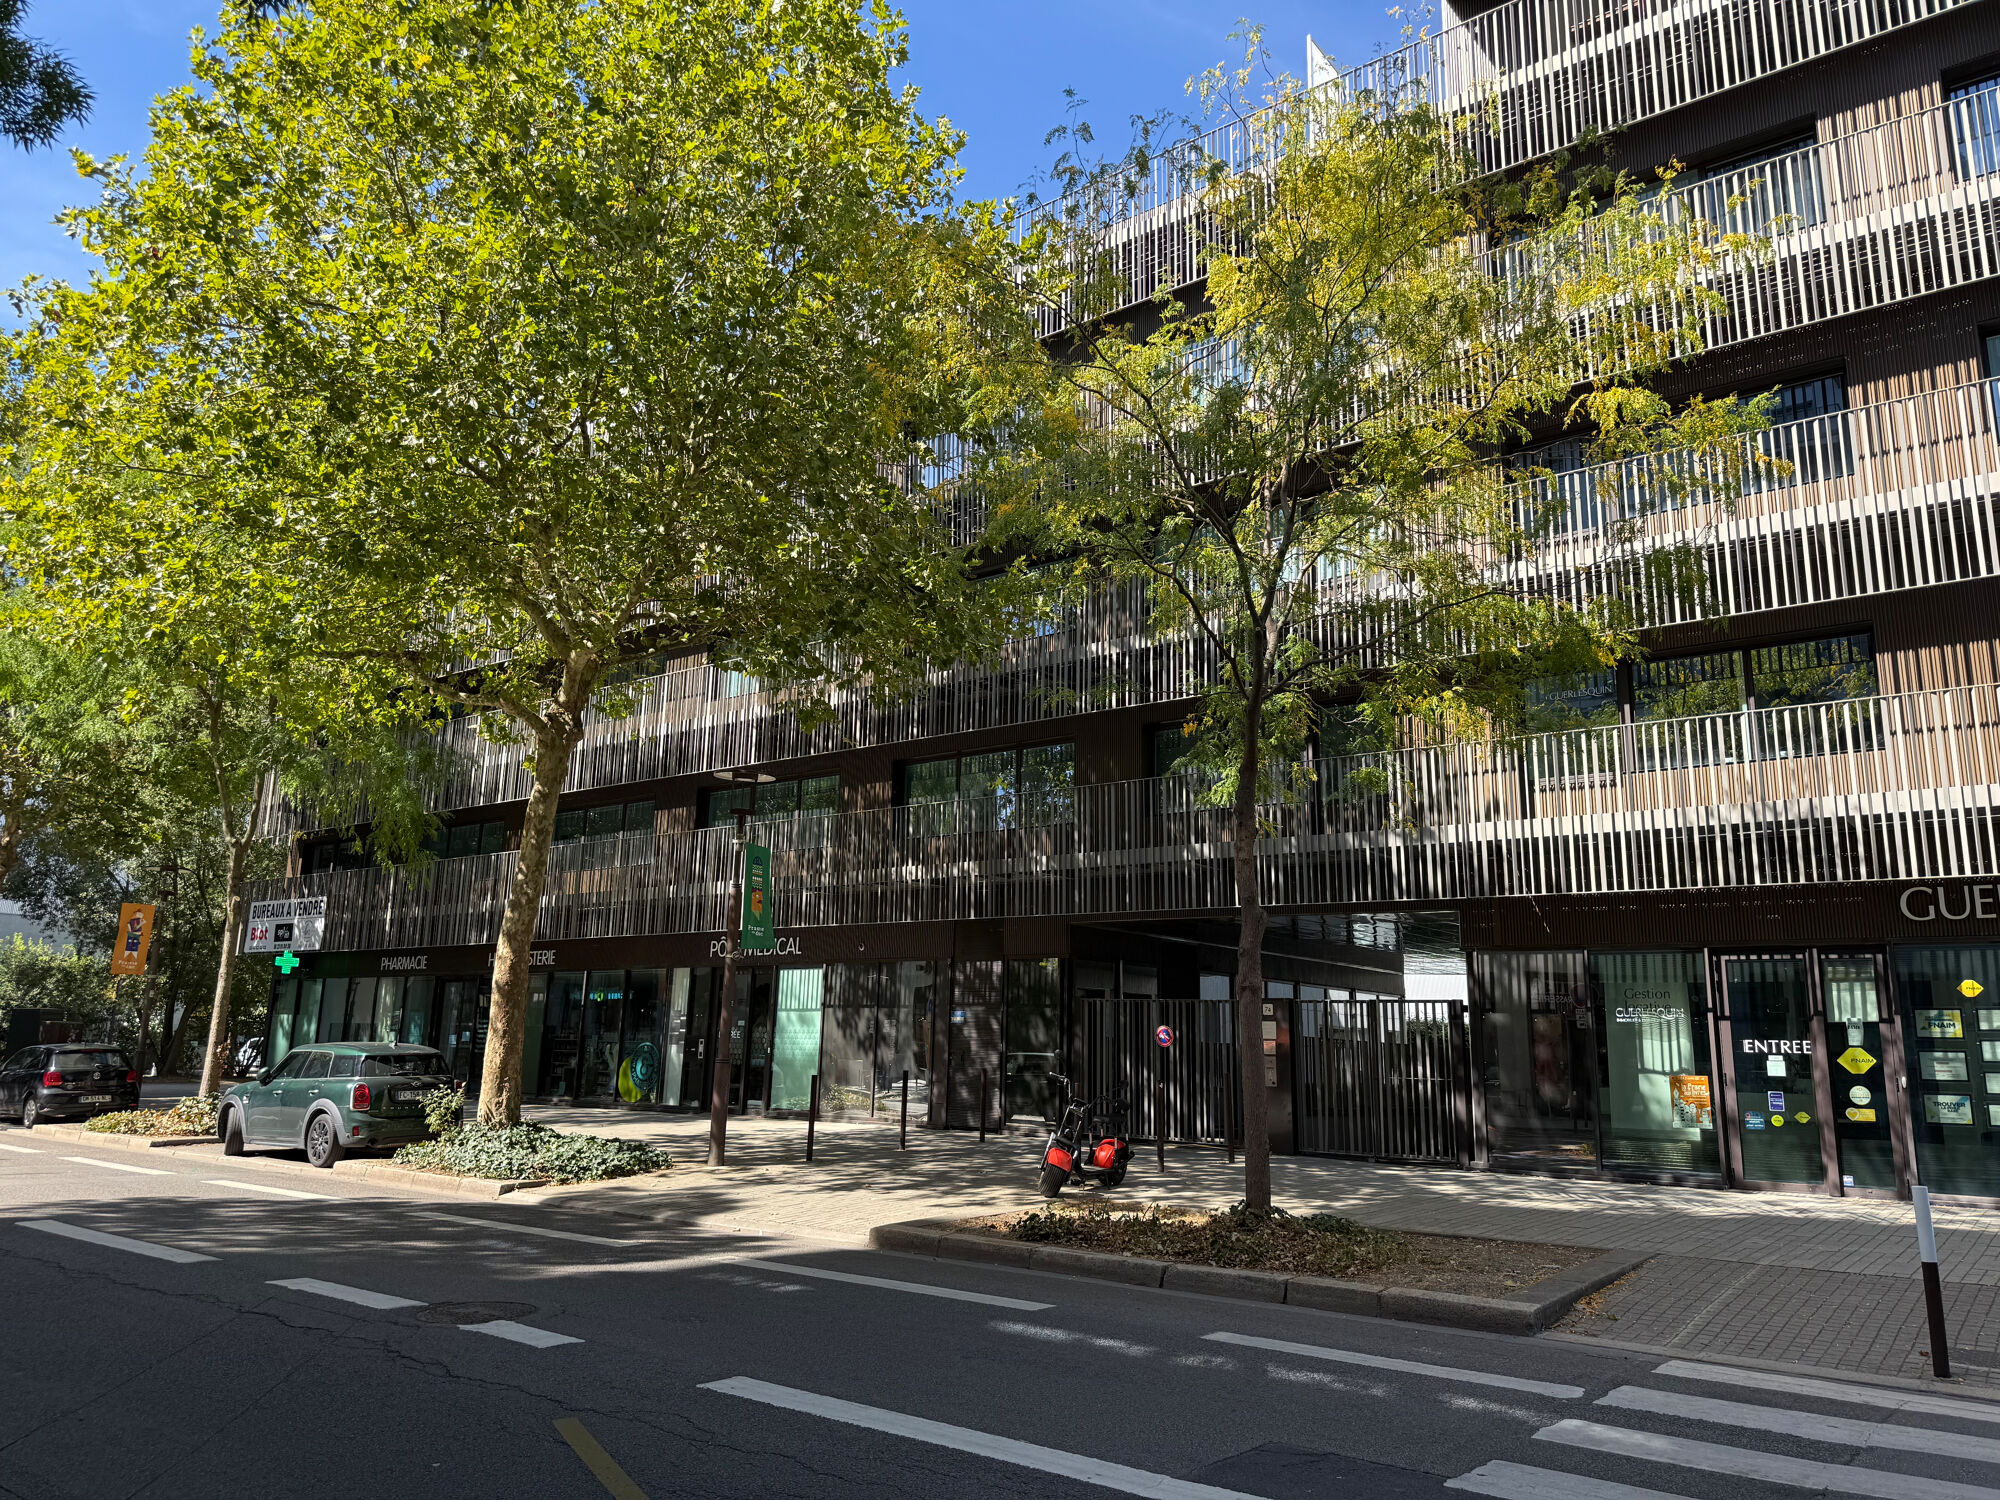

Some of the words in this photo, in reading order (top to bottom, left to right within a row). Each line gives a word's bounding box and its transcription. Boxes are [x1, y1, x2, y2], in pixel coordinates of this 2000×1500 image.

[252, 903, 286, 920] BUREAUX
[286, 902, 292, 917] A
[294, 900, 324, 917] VENDRE
[1900, 884, 2000, 921] GUE
[250, 927, 269, 941] Blot
[380, 955, 429, 971] PHARMACIE
[1624, 987, 1671, 1000] Gestion
[1743, 1039, 1812, 1054] ENTREE
